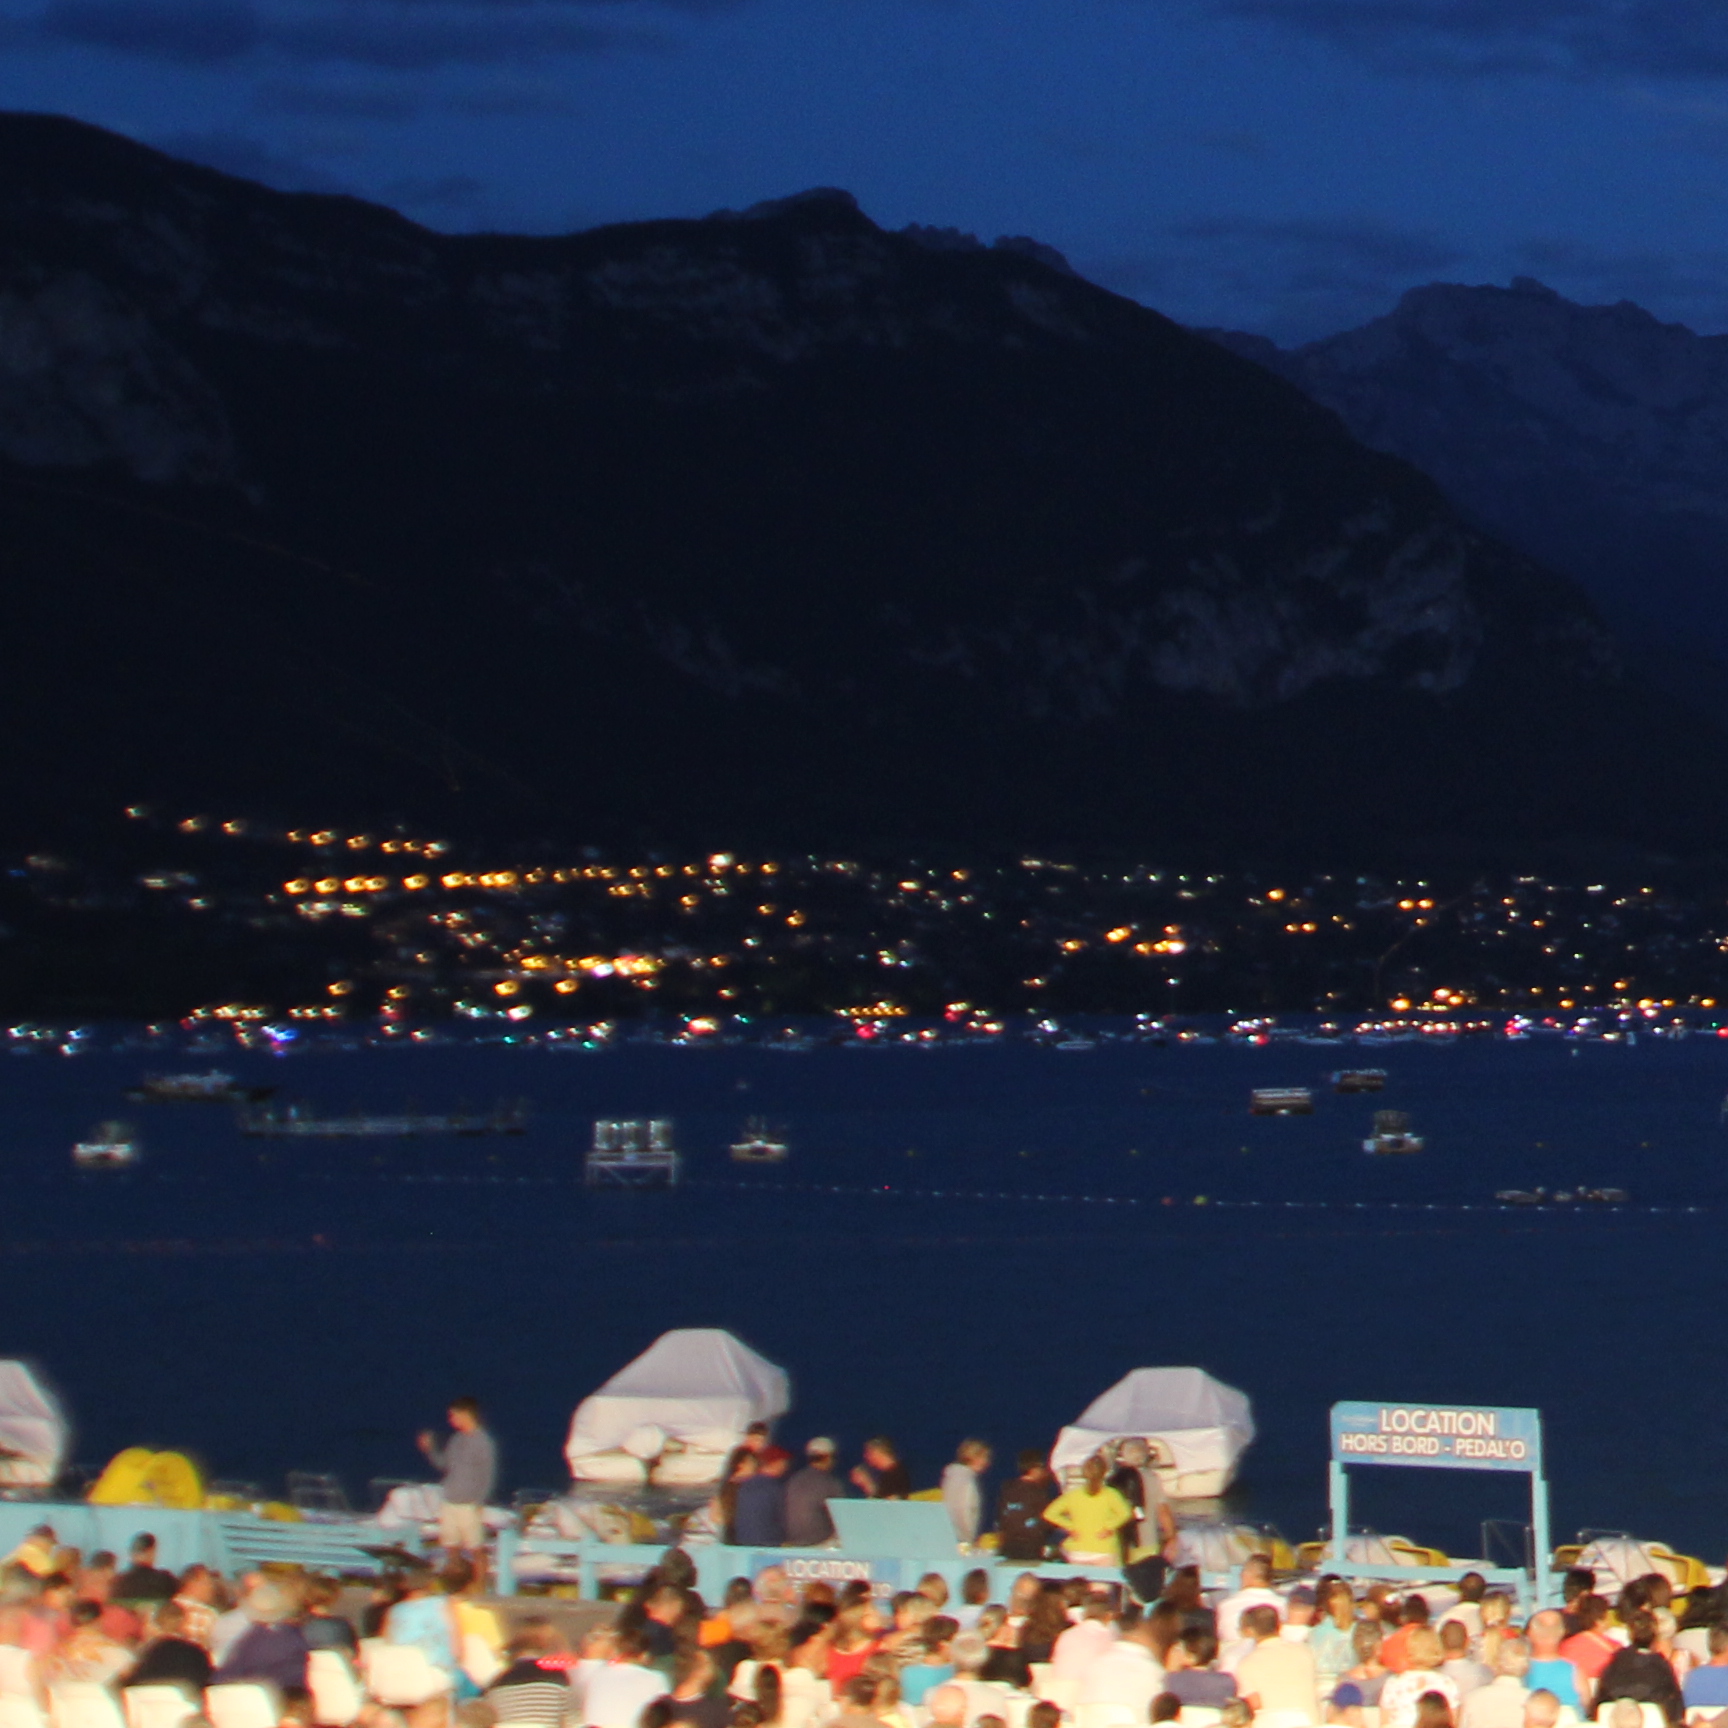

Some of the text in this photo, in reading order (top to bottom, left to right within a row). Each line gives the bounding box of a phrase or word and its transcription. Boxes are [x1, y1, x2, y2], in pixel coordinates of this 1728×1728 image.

[1381, 1409, 1495, 1436] LOCATION
[1341, 1433, 1387, 1453] HORS
[1392, 1435, 1439, 1455] BORD
[1456, 1438, 1525, 1458] PEDAL'O
[786, 1559, 869, 1578] LOCATION
